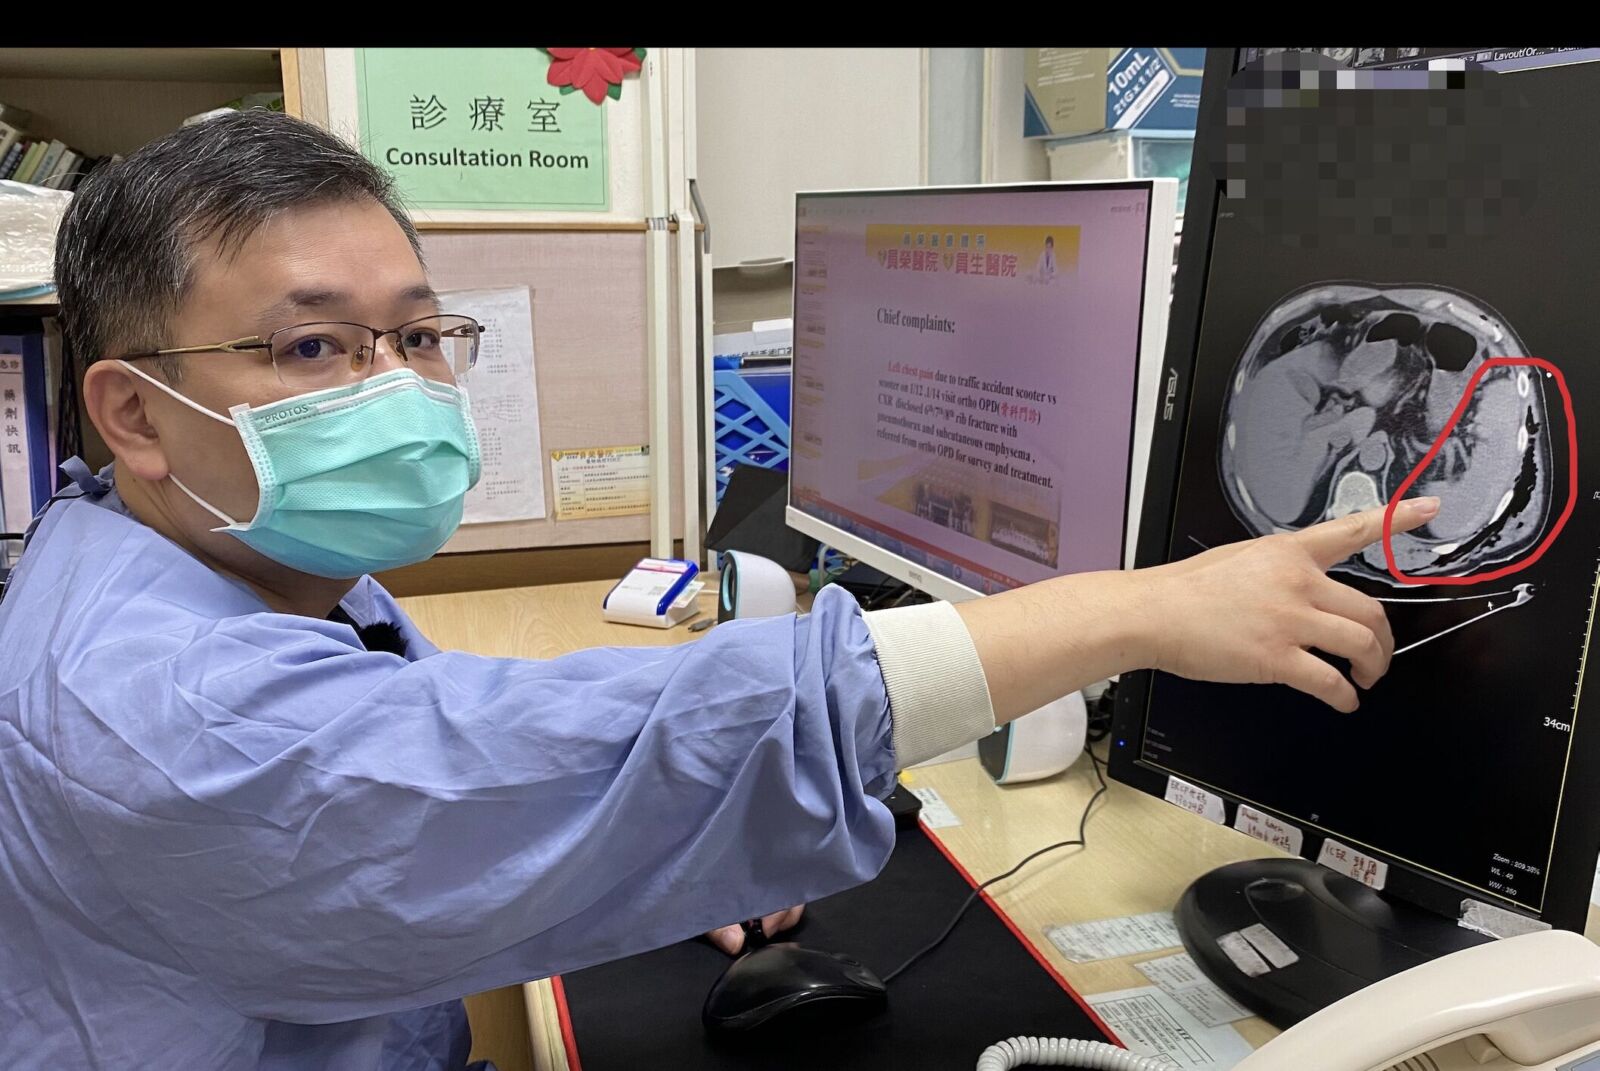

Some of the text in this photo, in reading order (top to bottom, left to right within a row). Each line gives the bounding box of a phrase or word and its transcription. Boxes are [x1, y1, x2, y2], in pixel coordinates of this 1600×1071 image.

[1108, 52, 1150, 96] 10mL
[409, 94, 562, 133] 診療室
[386, 147, 589, 169] Consultation Room
[885, 249, 1018, 278] 員榮醫院 員生醫院
[877, 307, 956, 334] Chief complaints:
[935, 369, 948, 383] due
[949, 375, 956, 385] to
[957, 376, 981, 390] traffic
[982, 380, 1014, 397] accident
[1016, 388, 1046, 403] scooter
[1047, 393, 1057, 405] vs
[941, 390, 956, 404] visit
[957, 395, 978, 409] ortho
[1163, 367, 1178, 421] ASUS
[264, 404, 309, 424] PROTOS
[955, 412, 967, 426] rib
[968, 414, 999, 434] fracture
[1000, 424, 1019, 439] with
[921, 424, 936, 436] and
[936, 427, 984, 449] subcutaneous
[984, 442, 1031, 463] emphysema
[937, 443, 955, 460] OPD
[955, 449, 967, 464] for
[968, 454, 992, 474] survey
[993, 461, 1010, 477] and
[1010, 465, 1054, 489] treatment.
[1542, 715, 1571, 733] 34cm
[1493, 853, 1511, 865] Zoom
[1505, 873, 1515, 881] 40
